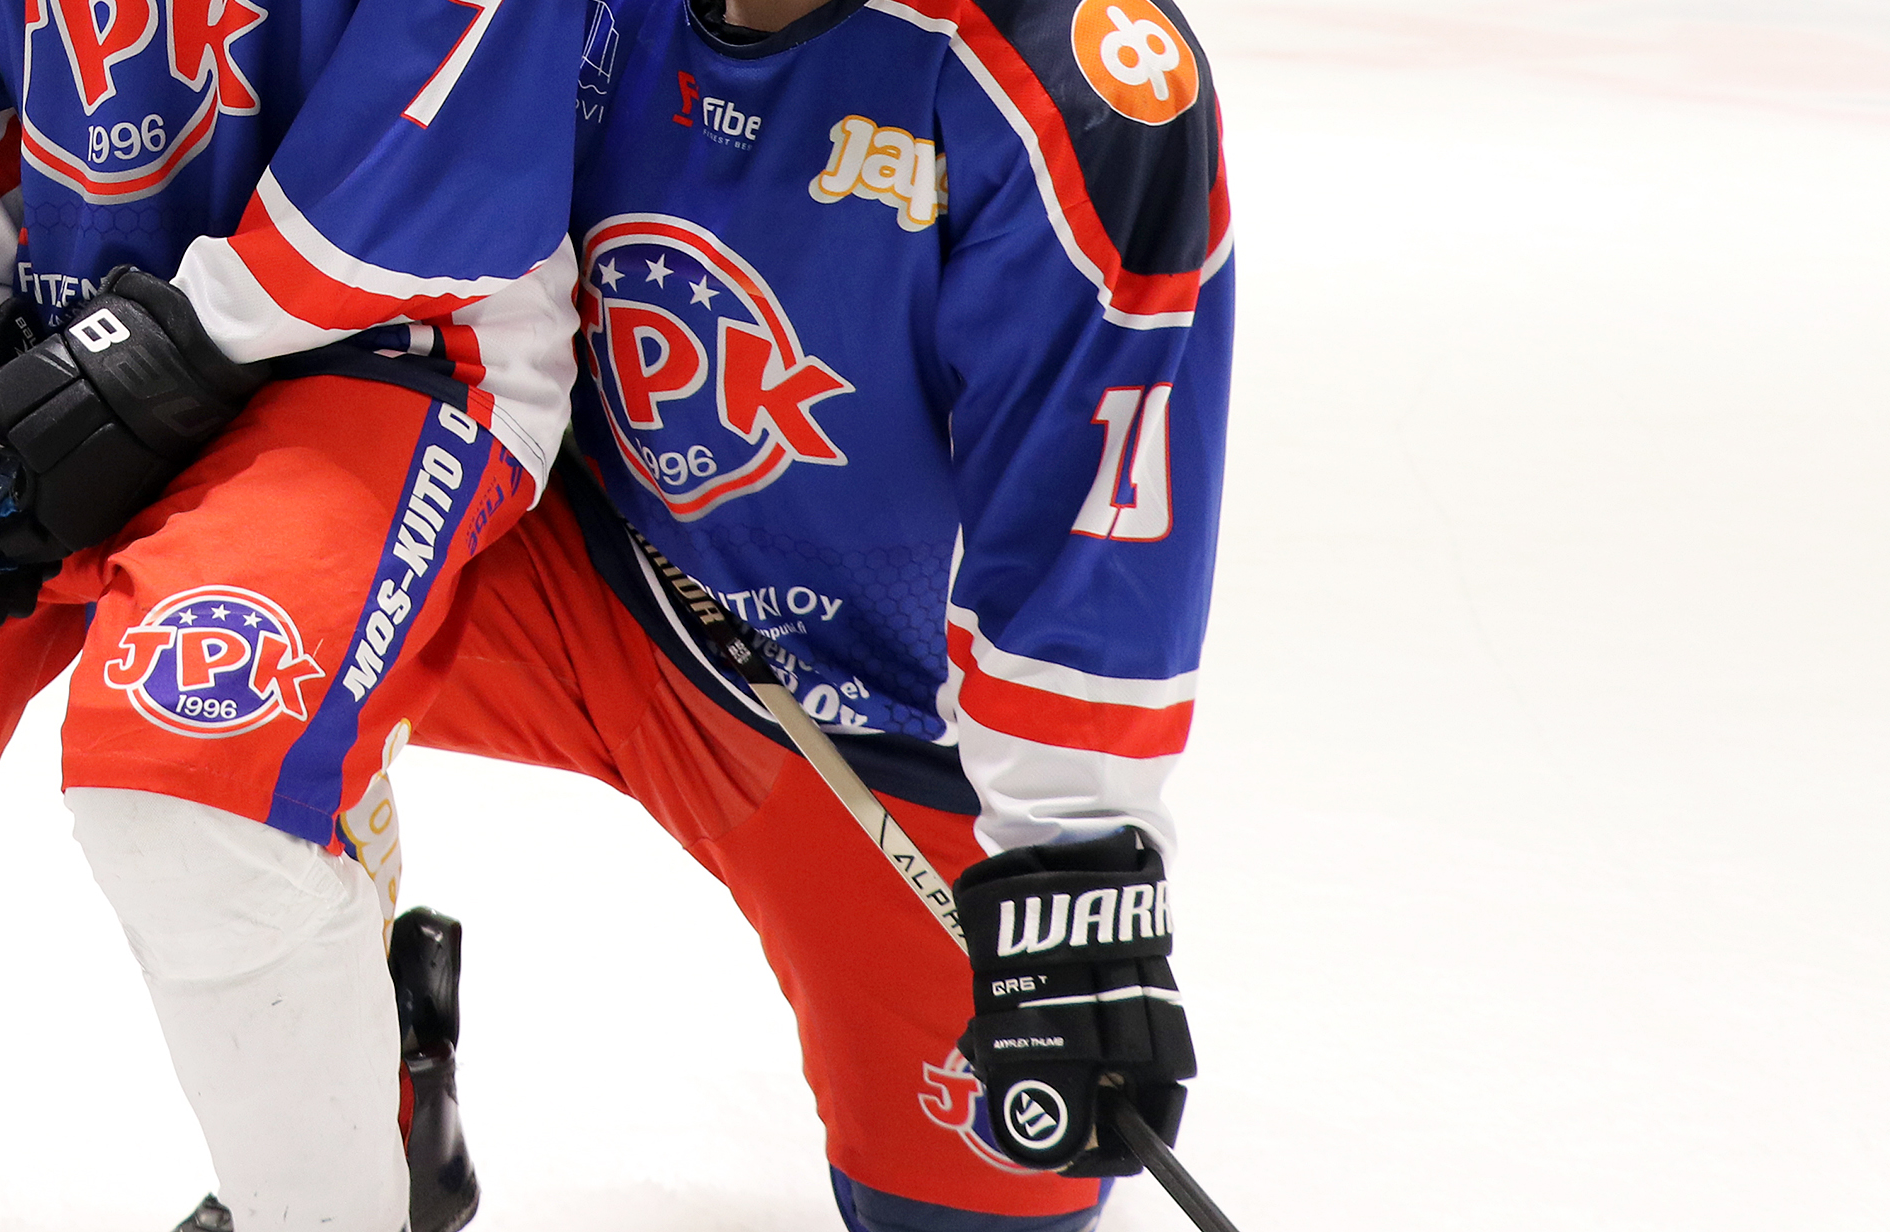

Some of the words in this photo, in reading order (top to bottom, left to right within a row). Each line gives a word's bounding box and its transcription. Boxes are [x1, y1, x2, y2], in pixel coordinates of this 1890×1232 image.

[86, 113, 167, 166] 1996
[786, 585, 844, 621] Oy
[103, 625, 326, 721] JPK
[174, 693, 239, 721] 1996
